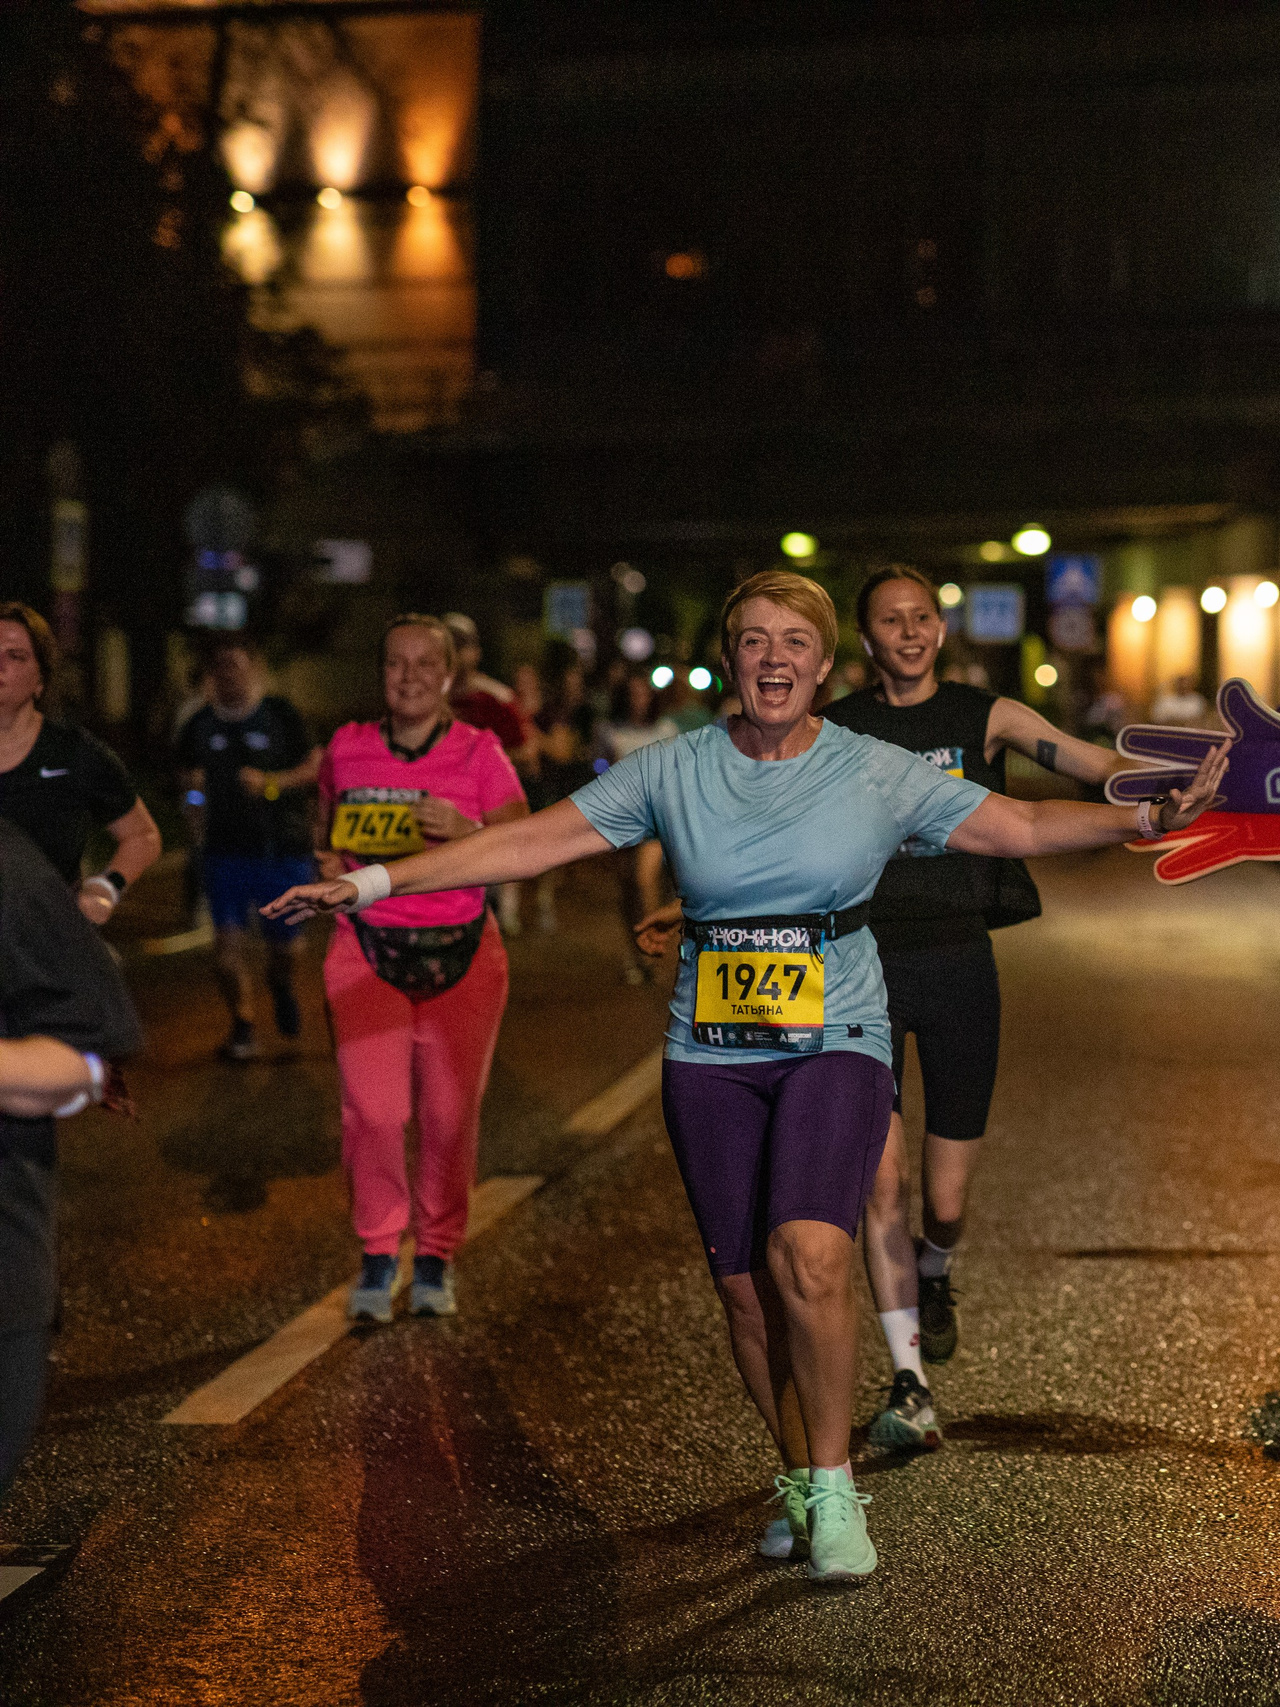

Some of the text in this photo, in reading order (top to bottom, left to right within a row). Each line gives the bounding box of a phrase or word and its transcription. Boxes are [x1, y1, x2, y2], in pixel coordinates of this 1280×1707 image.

[346, 812, 411, 838] 7474
[716, 963, 808, 1001] 1947
[731, 1004, 784, 1016] ТАТЬЯНА
